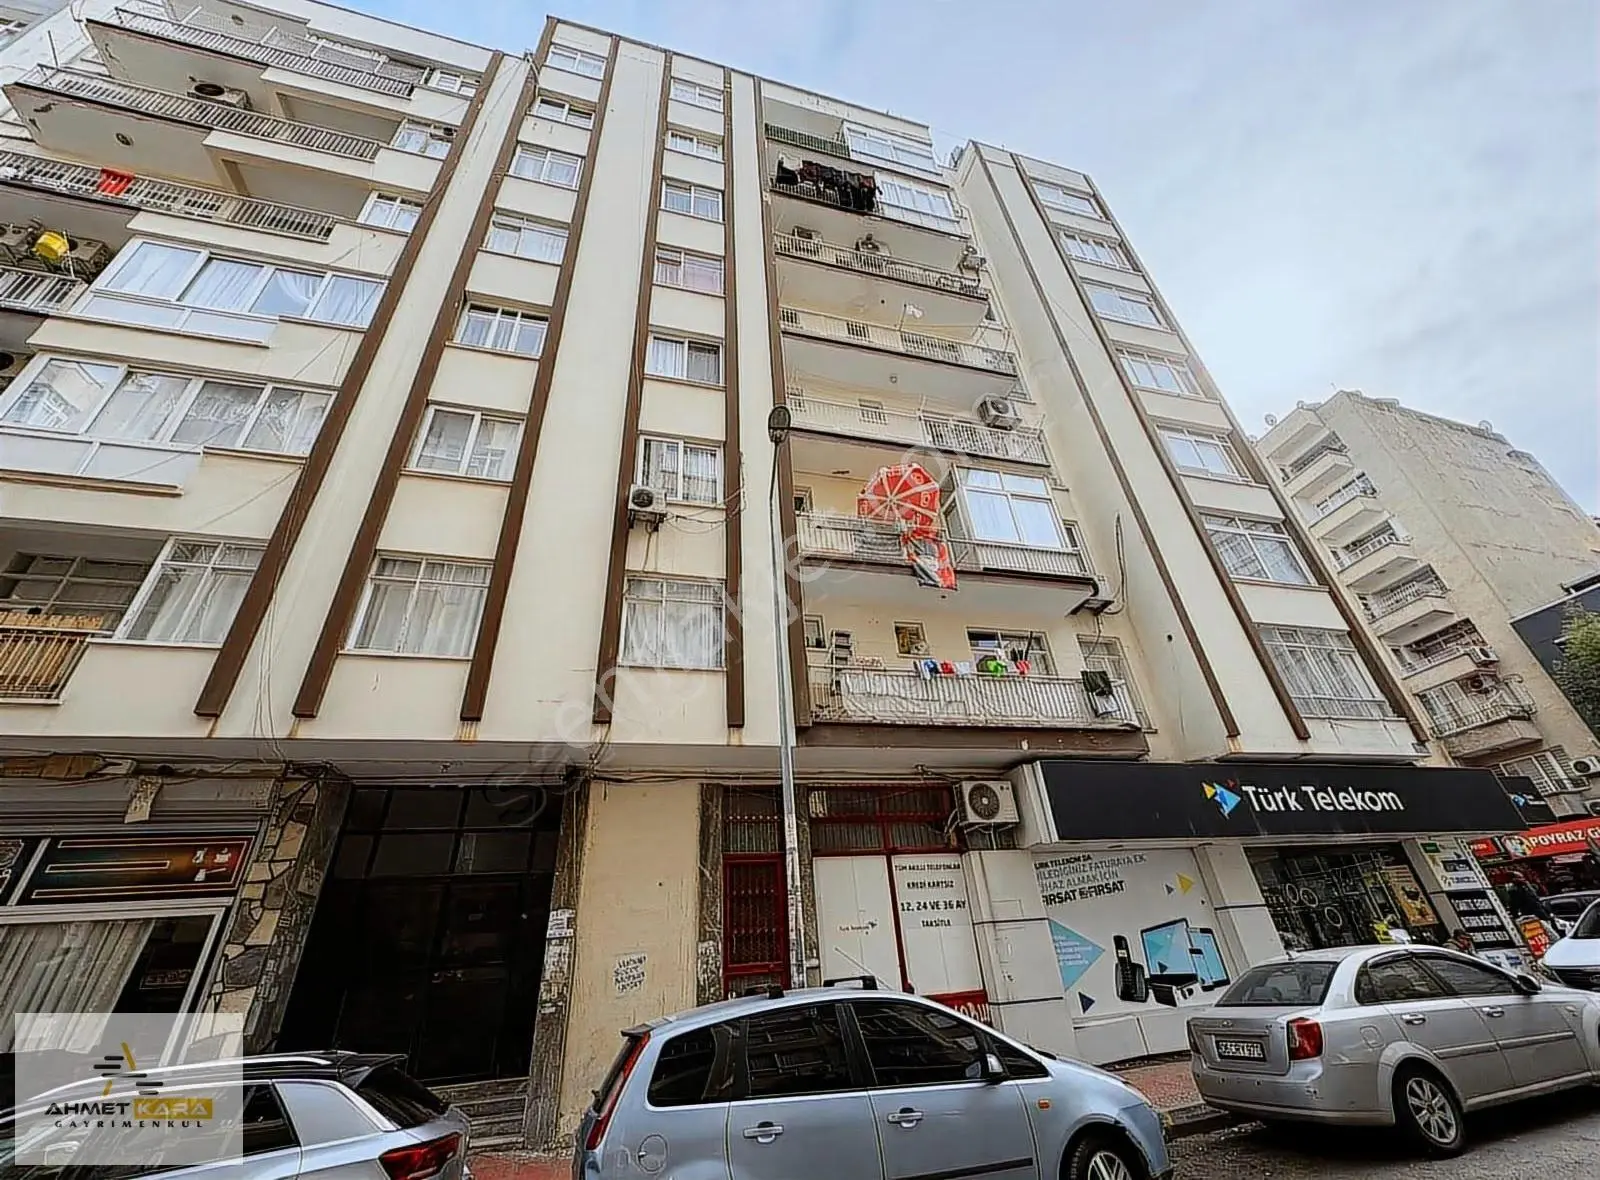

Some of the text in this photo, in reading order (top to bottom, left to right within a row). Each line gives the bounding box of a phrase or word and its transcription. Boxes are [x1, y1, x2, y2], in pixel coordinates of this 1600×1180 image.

[1241, 785, 1405, 812] Türk Telekom
[1529, 829, 1586, 847] POYRAZ
[916, 901, 928, 911] 24
[928, 900, 942, 910] VE
[943, 900, 955, 910] 36
[955, 899, 967, 909] AY
